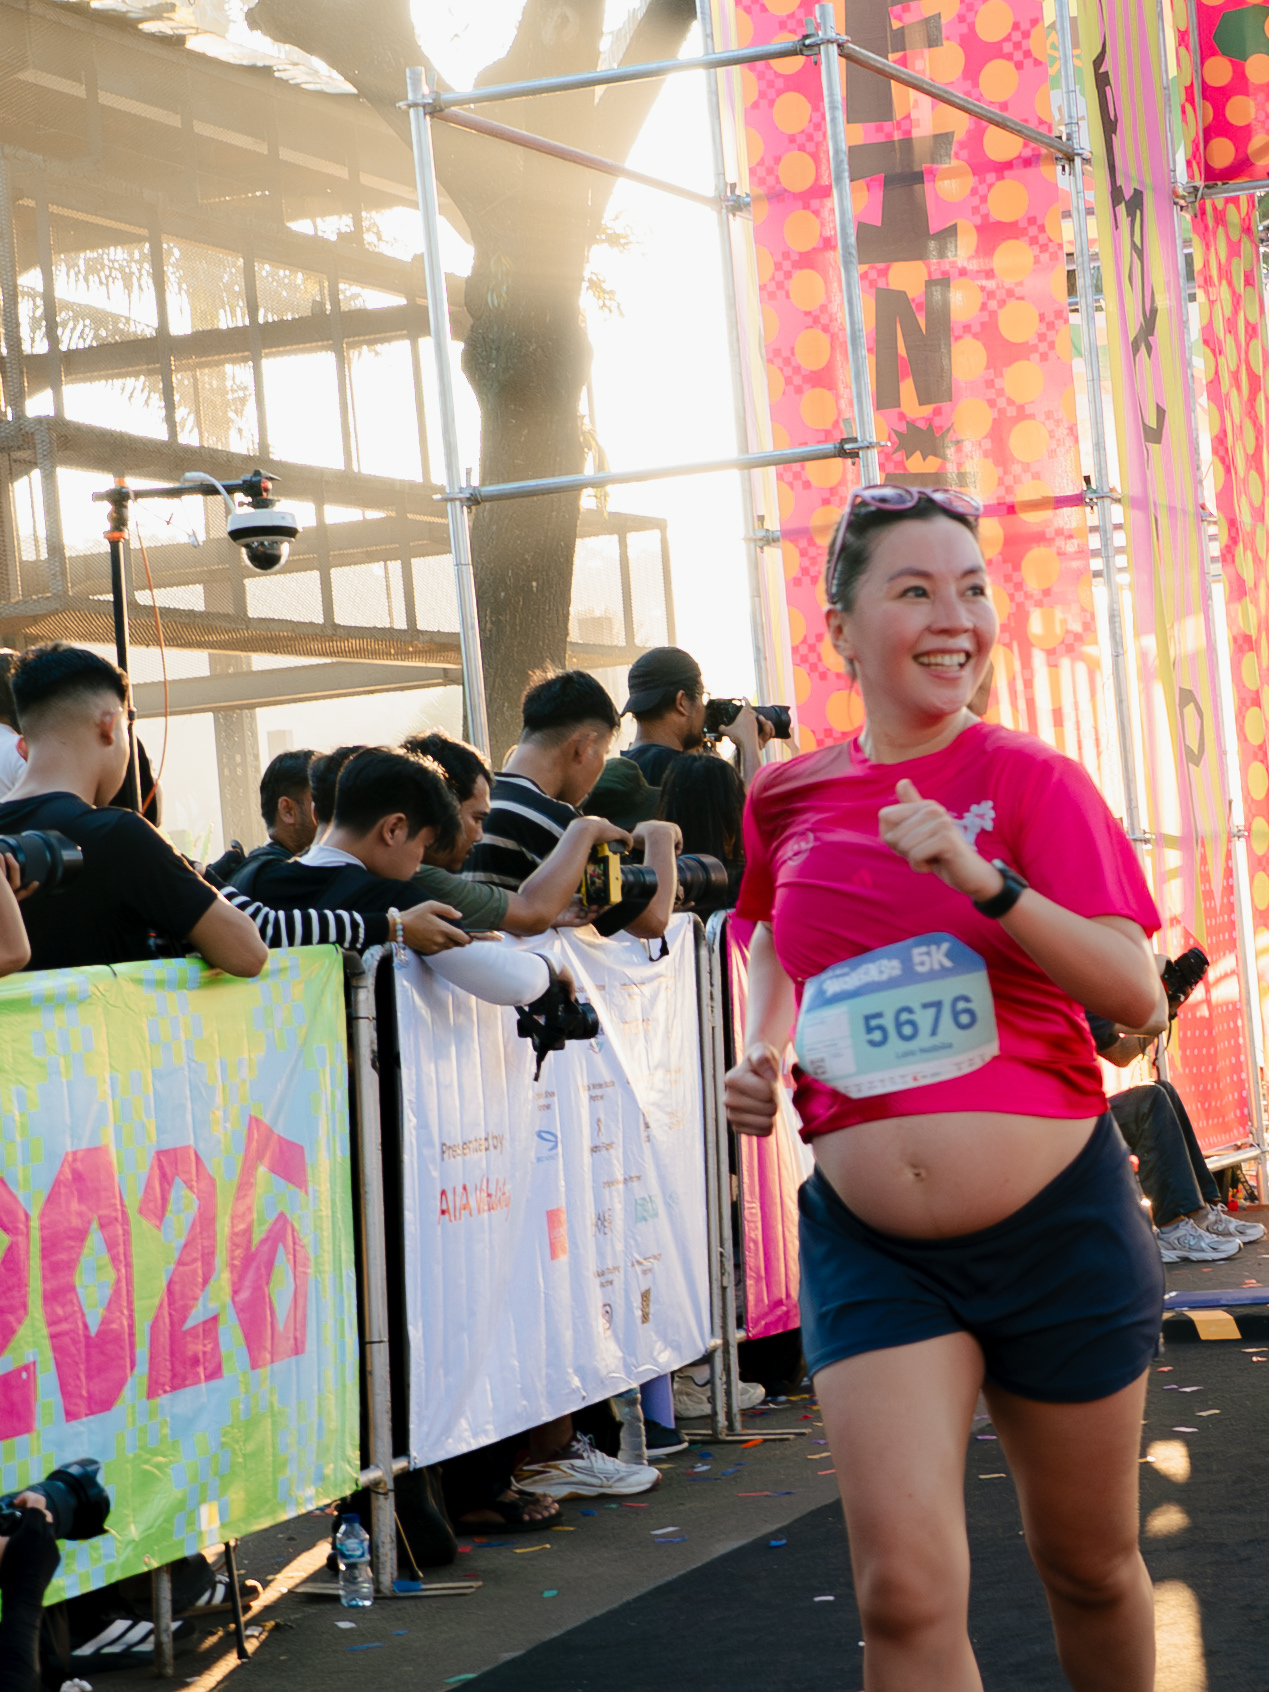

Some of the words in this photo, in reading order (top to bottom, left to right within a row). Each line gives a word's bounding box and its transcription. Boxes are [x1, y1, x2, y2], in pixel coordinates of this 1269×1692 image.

[910, 942, 954, 973] 5K
[863, 994, 978, 1048] 5676
[440, 1132, 490, 1163] Presented
[492, 1130, 504, 1155] by
[437, 1183, 473, 1225] AIA
